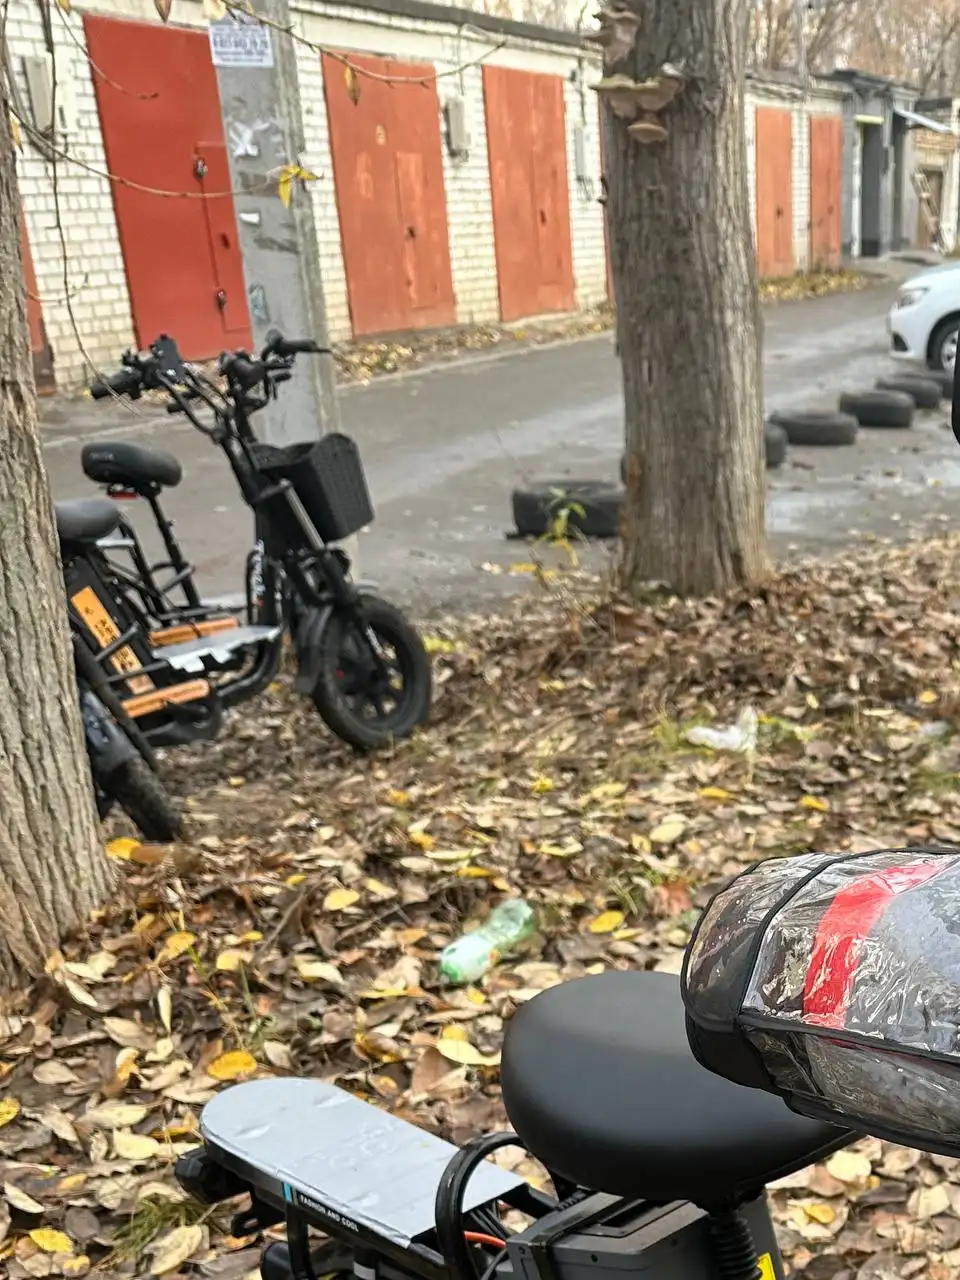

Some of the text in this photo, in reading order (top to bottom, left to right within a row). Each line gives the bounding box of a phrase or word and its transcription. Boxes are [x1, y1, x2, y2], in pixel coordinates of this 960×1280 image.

[300, 1194, 359, 1233] FASHION AND COOL
